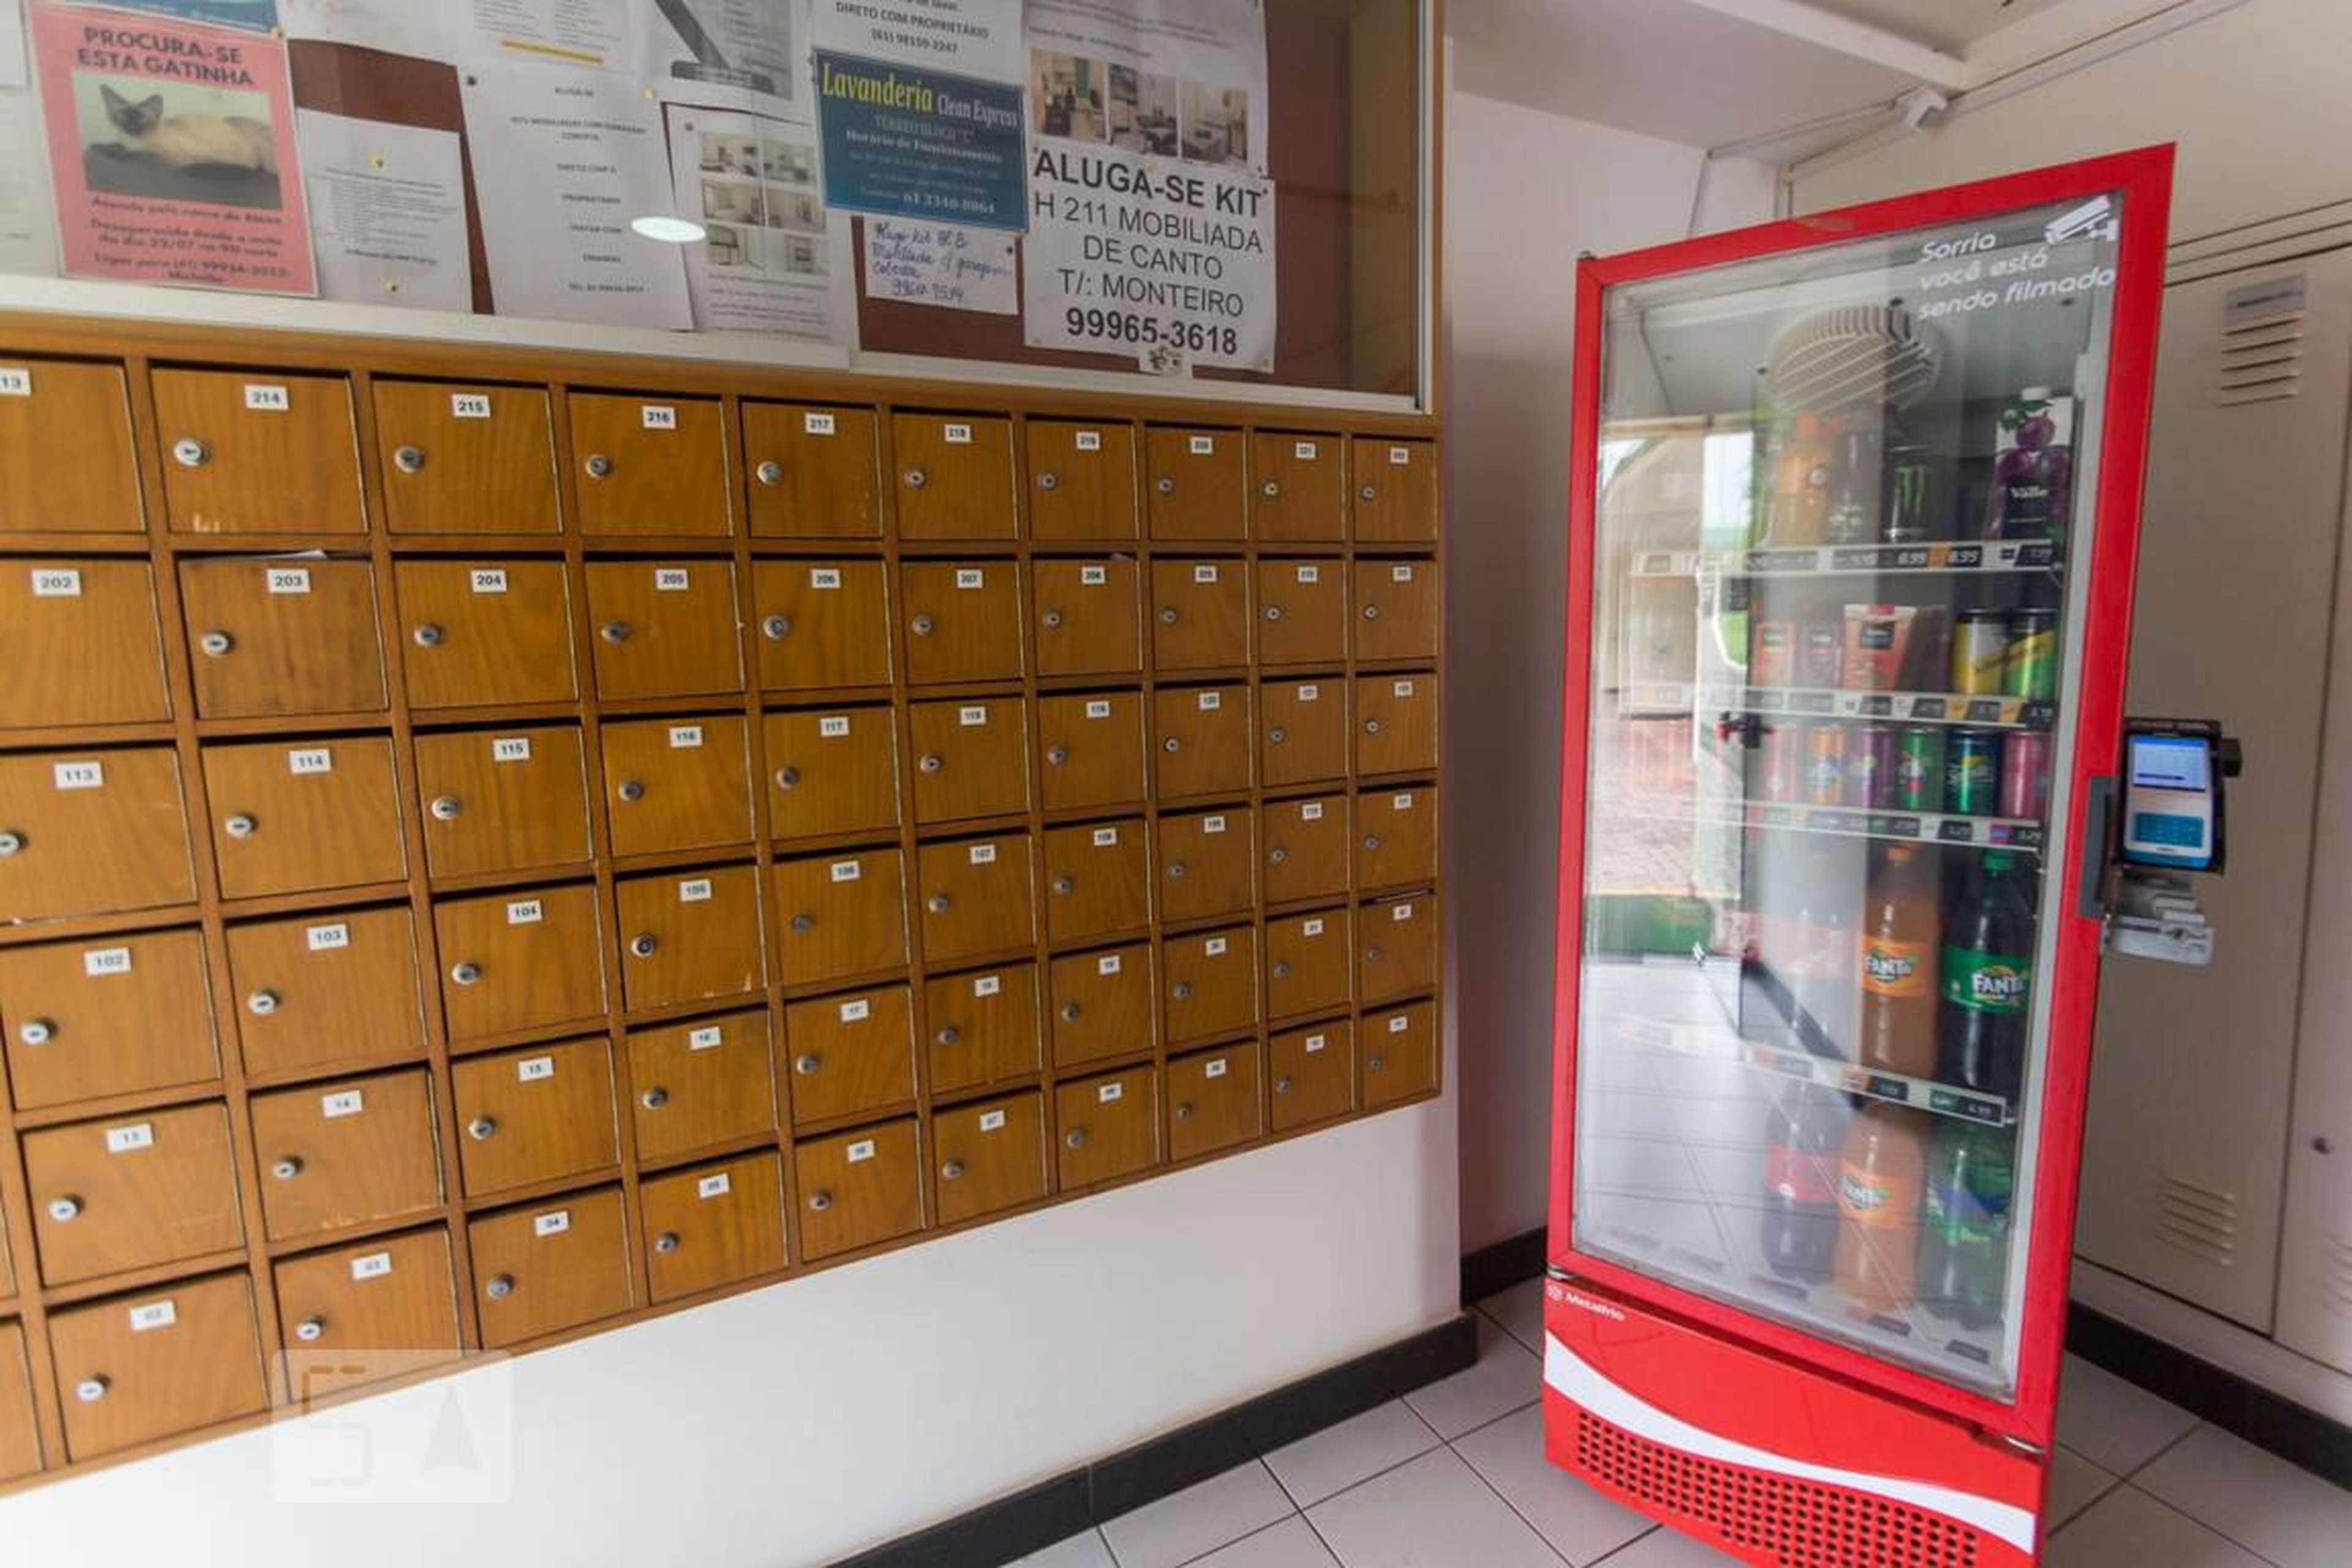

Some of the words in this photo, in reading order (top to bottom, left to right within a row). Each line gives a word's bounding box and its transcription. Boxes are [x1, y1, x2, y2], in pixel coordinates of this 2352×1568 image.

[836, 2, 877, 19] DIRETO
[880, 9, 908, 24] COM
[84, 27, 242, 64] PROCURA-SE
[77, 48, 138, 69] ESTA
[144, 58, 254, 85] GATINHA
[823, 63, 932, 112] Lavanderia
[938, 95, 970, 119] Clean
[974, 100, 1018, 127] Express
[1034, 150, 1205, 208] ALUGA-SE
[1216, 184, 1262, 217] KIT
[1034, 191, 1054, 219] H
[1063, 197, 1107, 226] 211
[1119, 206, 1263, 254] MOBILIADA
[1921, 232, 1997, 263] Sorria
[1084, 235, 1123, 264] DE
[1130, 244, 1223, 280] CANTO
[1921, 260, 1981, 292] você
[1989, 247, 2049, 276] está
[1057, 268, 1092, 296] T/:
[1102, 273, 1243, 317] MONTEIRO
[1918, 290, 1999, 321] sendo
[2005, 266, 2116, 304] filmado
[1066, 307, 1237, 355] 99965-3618
[254, 391, 281, 404] 214
[458, 401, 483, 413] 215
[647, 412, 670, 423] 216
[42, 576, 72, 589] 202
[274, 575, 303, 587] 203
[477, 574, 502, 586] 204
[663, 573, 685, 585] 205
[676, 731, 696, 741] 116
[501, 742, 524, 755] 115
[298, 755, 323, 767] 114
[66, 769, 94, 781] 113
[515, 905, 537, 917] 104
[317, 930, 342, 943] 103
[96, 954, 124, 967] 102
[529, 1063, 542, 1074] 15
